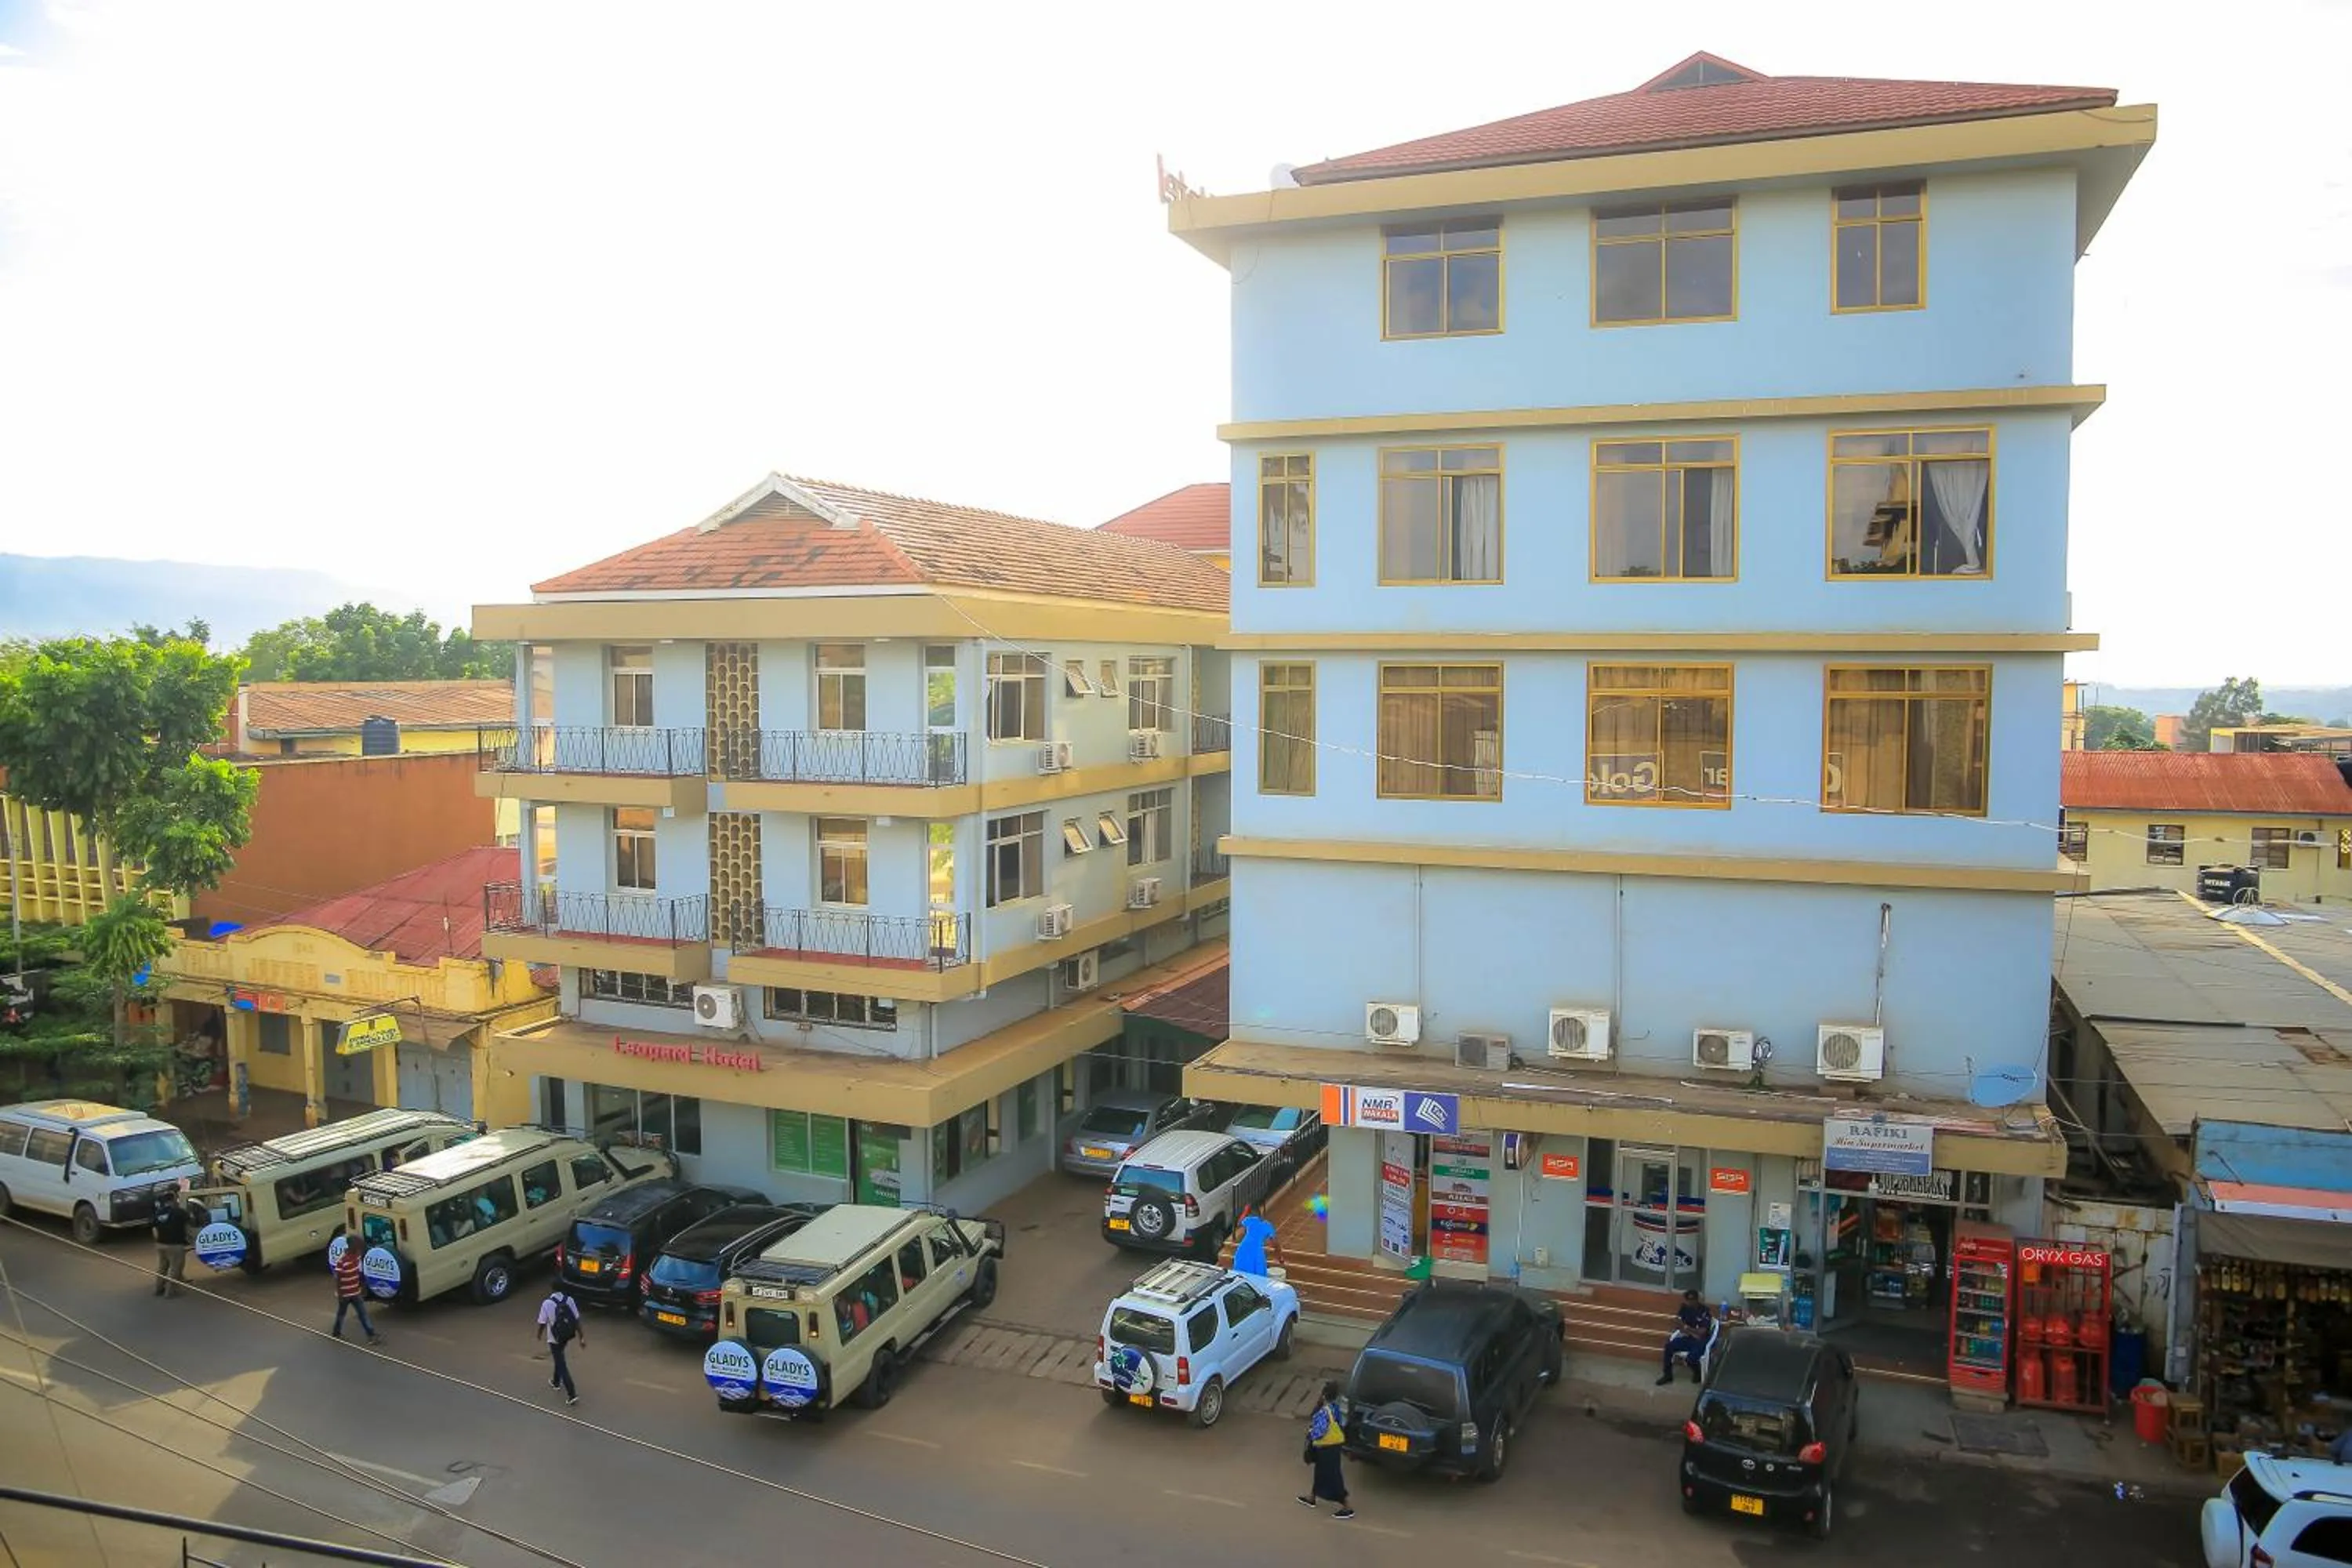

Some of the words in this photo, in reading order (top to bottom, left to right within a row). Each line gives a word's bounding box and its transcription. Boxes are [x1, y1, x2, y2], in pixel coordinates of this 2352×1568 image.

[1849, 1126, 1907, 1139] RAFIKI
[198, 1231, 238, 1244] GLADYS
[365, 1255, 394, 1271] GLADYS
[2021, 1247, 2063, 1262] ORYX
[2069, 1252, 2103, 1266] GAS
[708, 1351, 750, 1369] GLADYS
[768, 1359, 810, 1376] GLADYS
